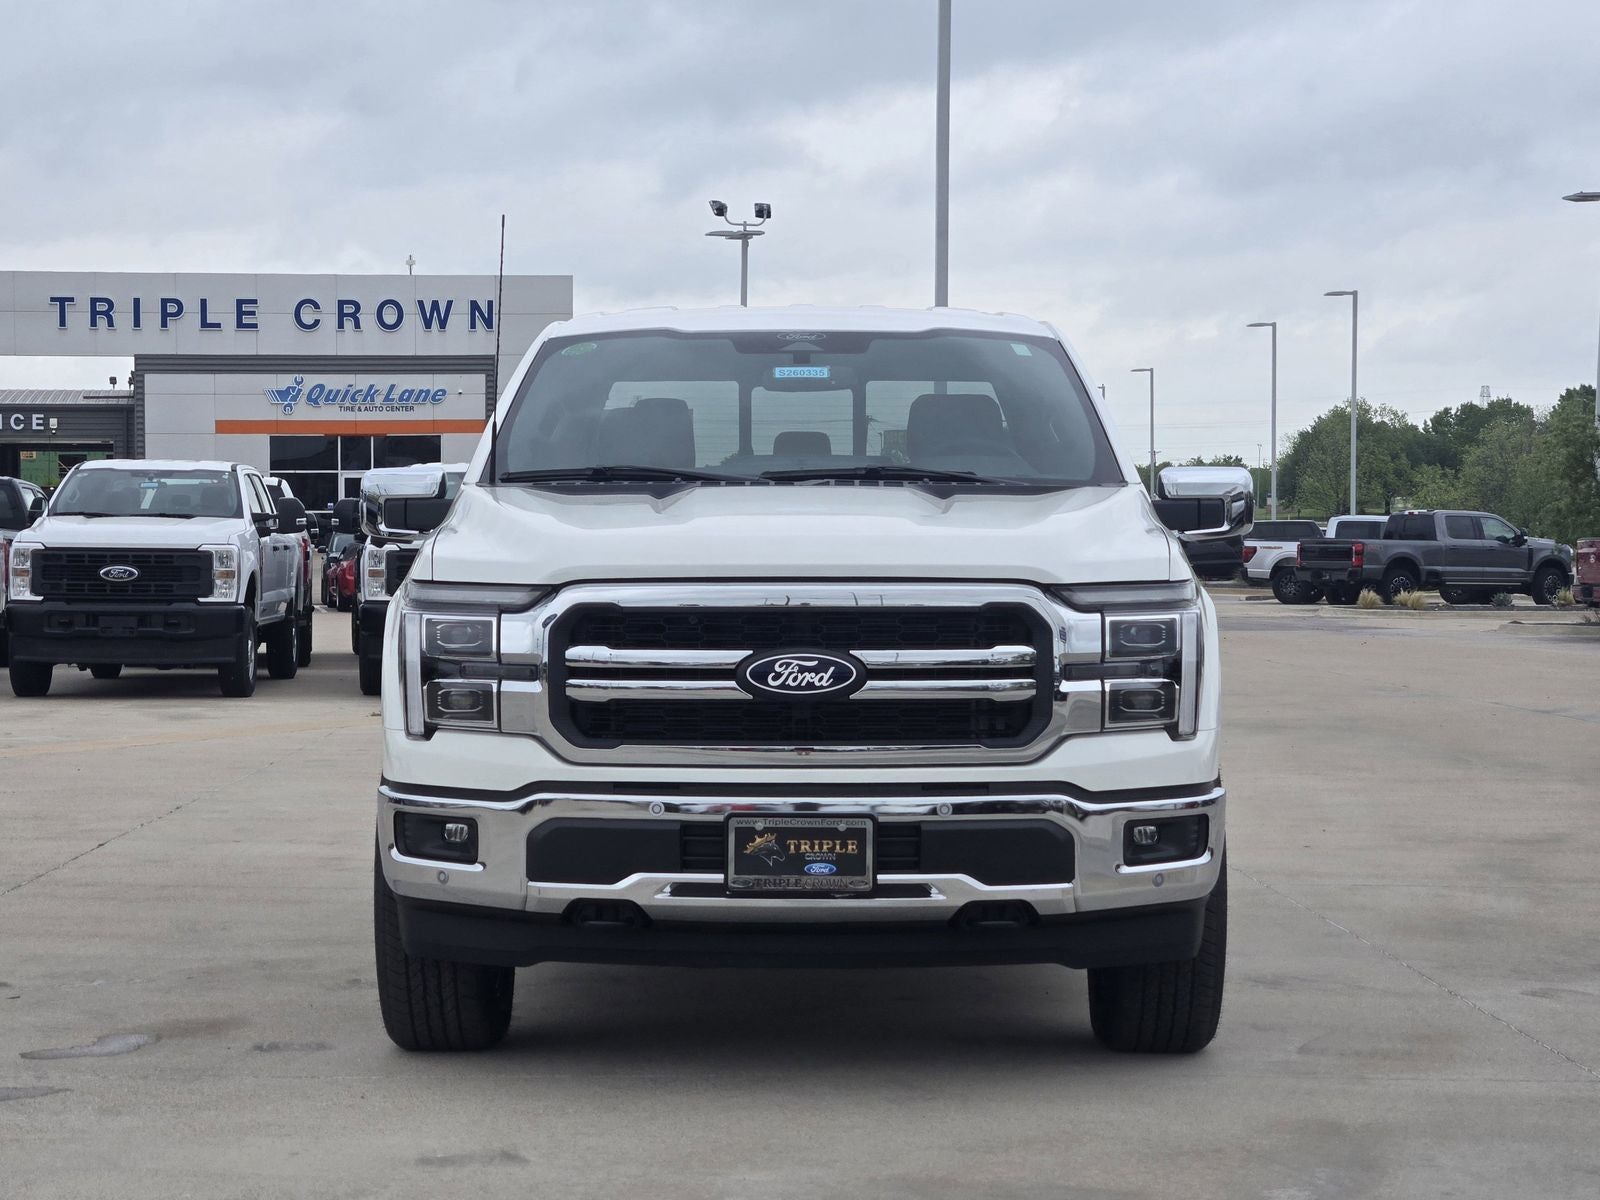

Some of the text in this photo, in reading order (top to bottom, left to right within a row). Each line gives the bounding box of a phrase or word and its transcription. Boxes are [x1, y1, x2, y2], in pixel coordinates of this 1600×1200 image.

[49, 296, 496, 332] TRIPLE CROWN
[778, 369, 825, 377] S260335
[306, 383, 448, 407] Quick Lane
[108, 568, 130, 579] Ford
[767, 659, 835, 687] Ford
[786, 839, 858, 854] TRIPLE
[804, 853, 837, 861] CROWN
[810, 864, 830, 874] Ford
[754, 878, 802, 889] TRIPLE
